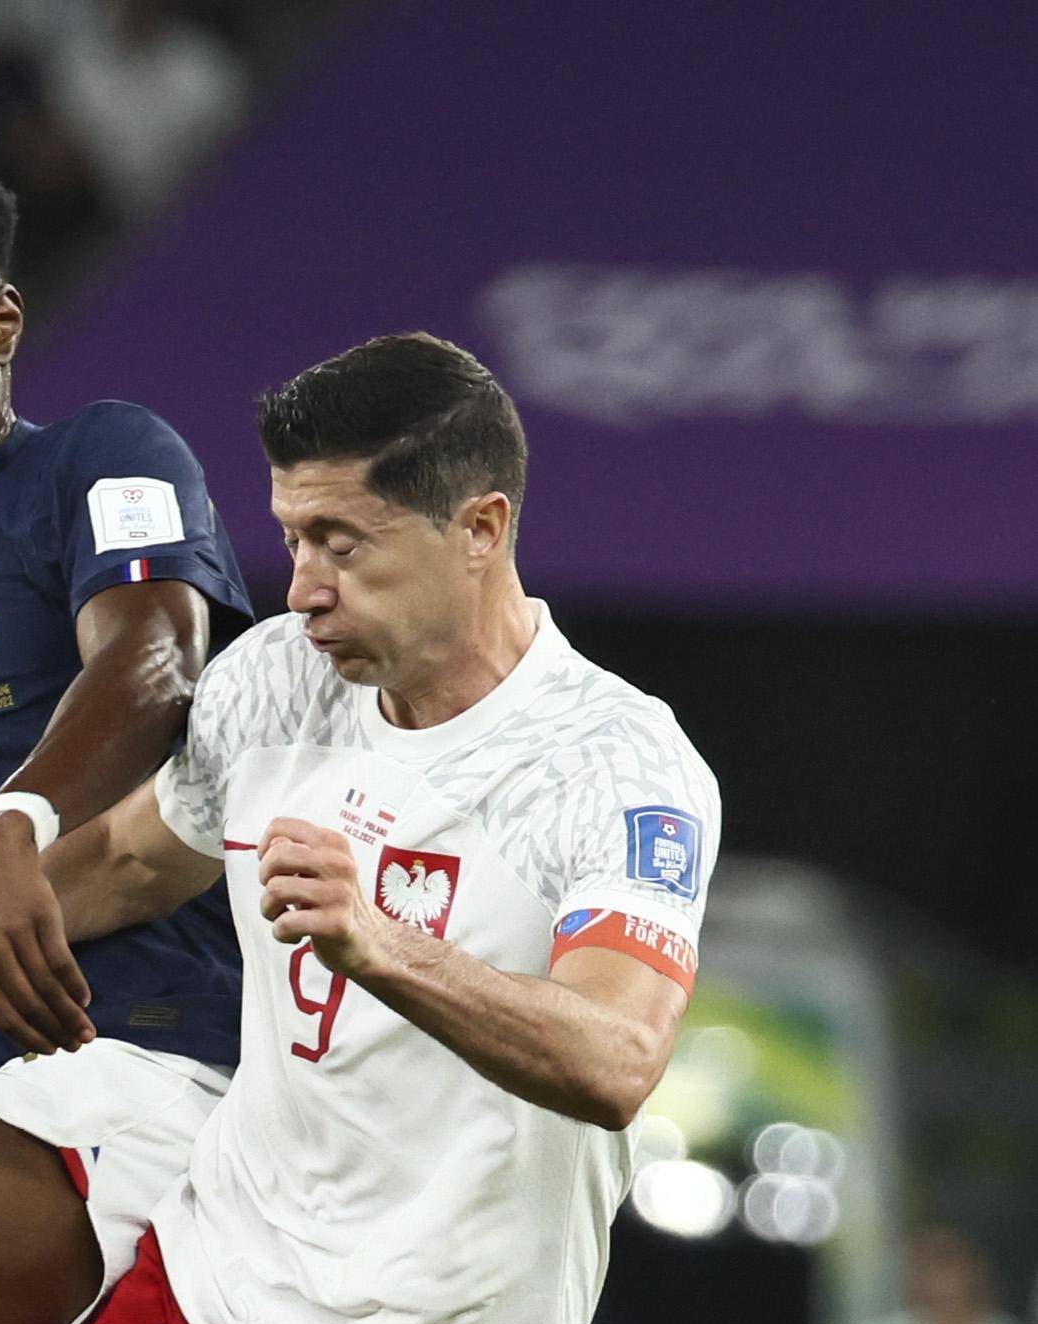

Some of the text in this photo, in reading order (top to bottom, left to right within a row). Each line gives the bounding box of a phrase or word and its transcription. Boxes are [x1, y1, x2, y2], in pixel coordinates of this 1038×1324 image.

[364, 820, 388, 837] POLAND
[654, 846, 687, 862] UNITES
[625, 922, 689, 973] FOR ALL
[289, 941, 349, 1064] 9
